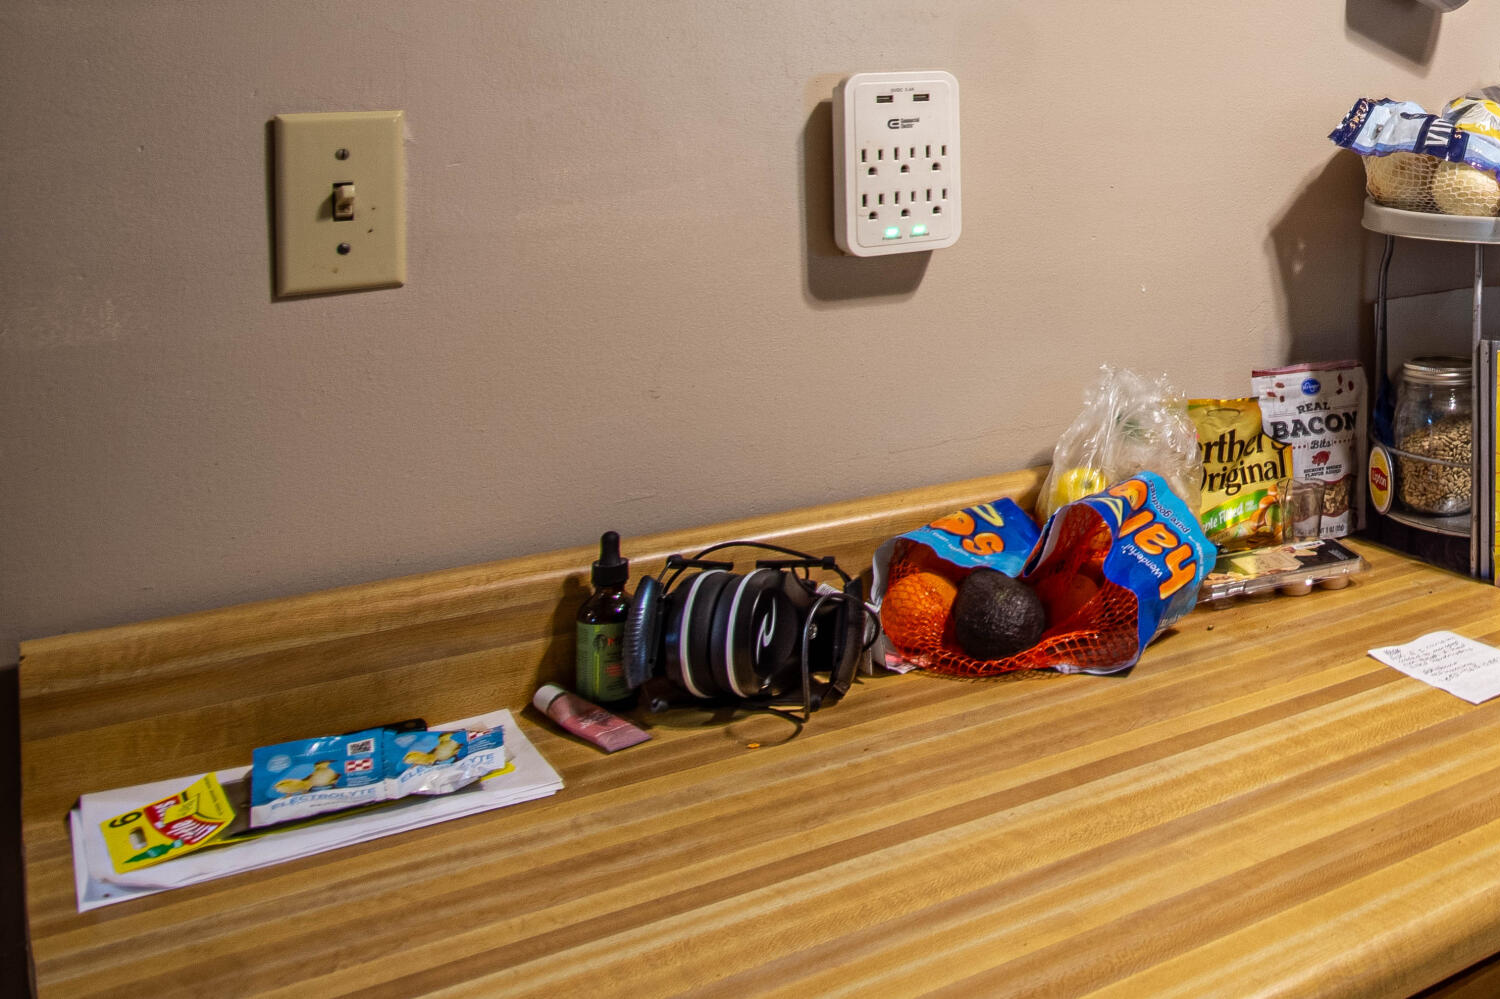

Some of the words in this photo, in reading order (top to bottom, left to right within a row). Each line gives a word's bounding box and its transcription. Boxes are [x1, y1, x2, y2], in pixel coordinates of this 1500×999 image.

[1296, 402, 1332, 415] REAL
[1271, 411, 1358, 440] BACON
[1310, 439, 1332, 450] Bits
[1372, 471, 1388, 489] Lipton
[1122, 544, 1164, 579] Wonderful
